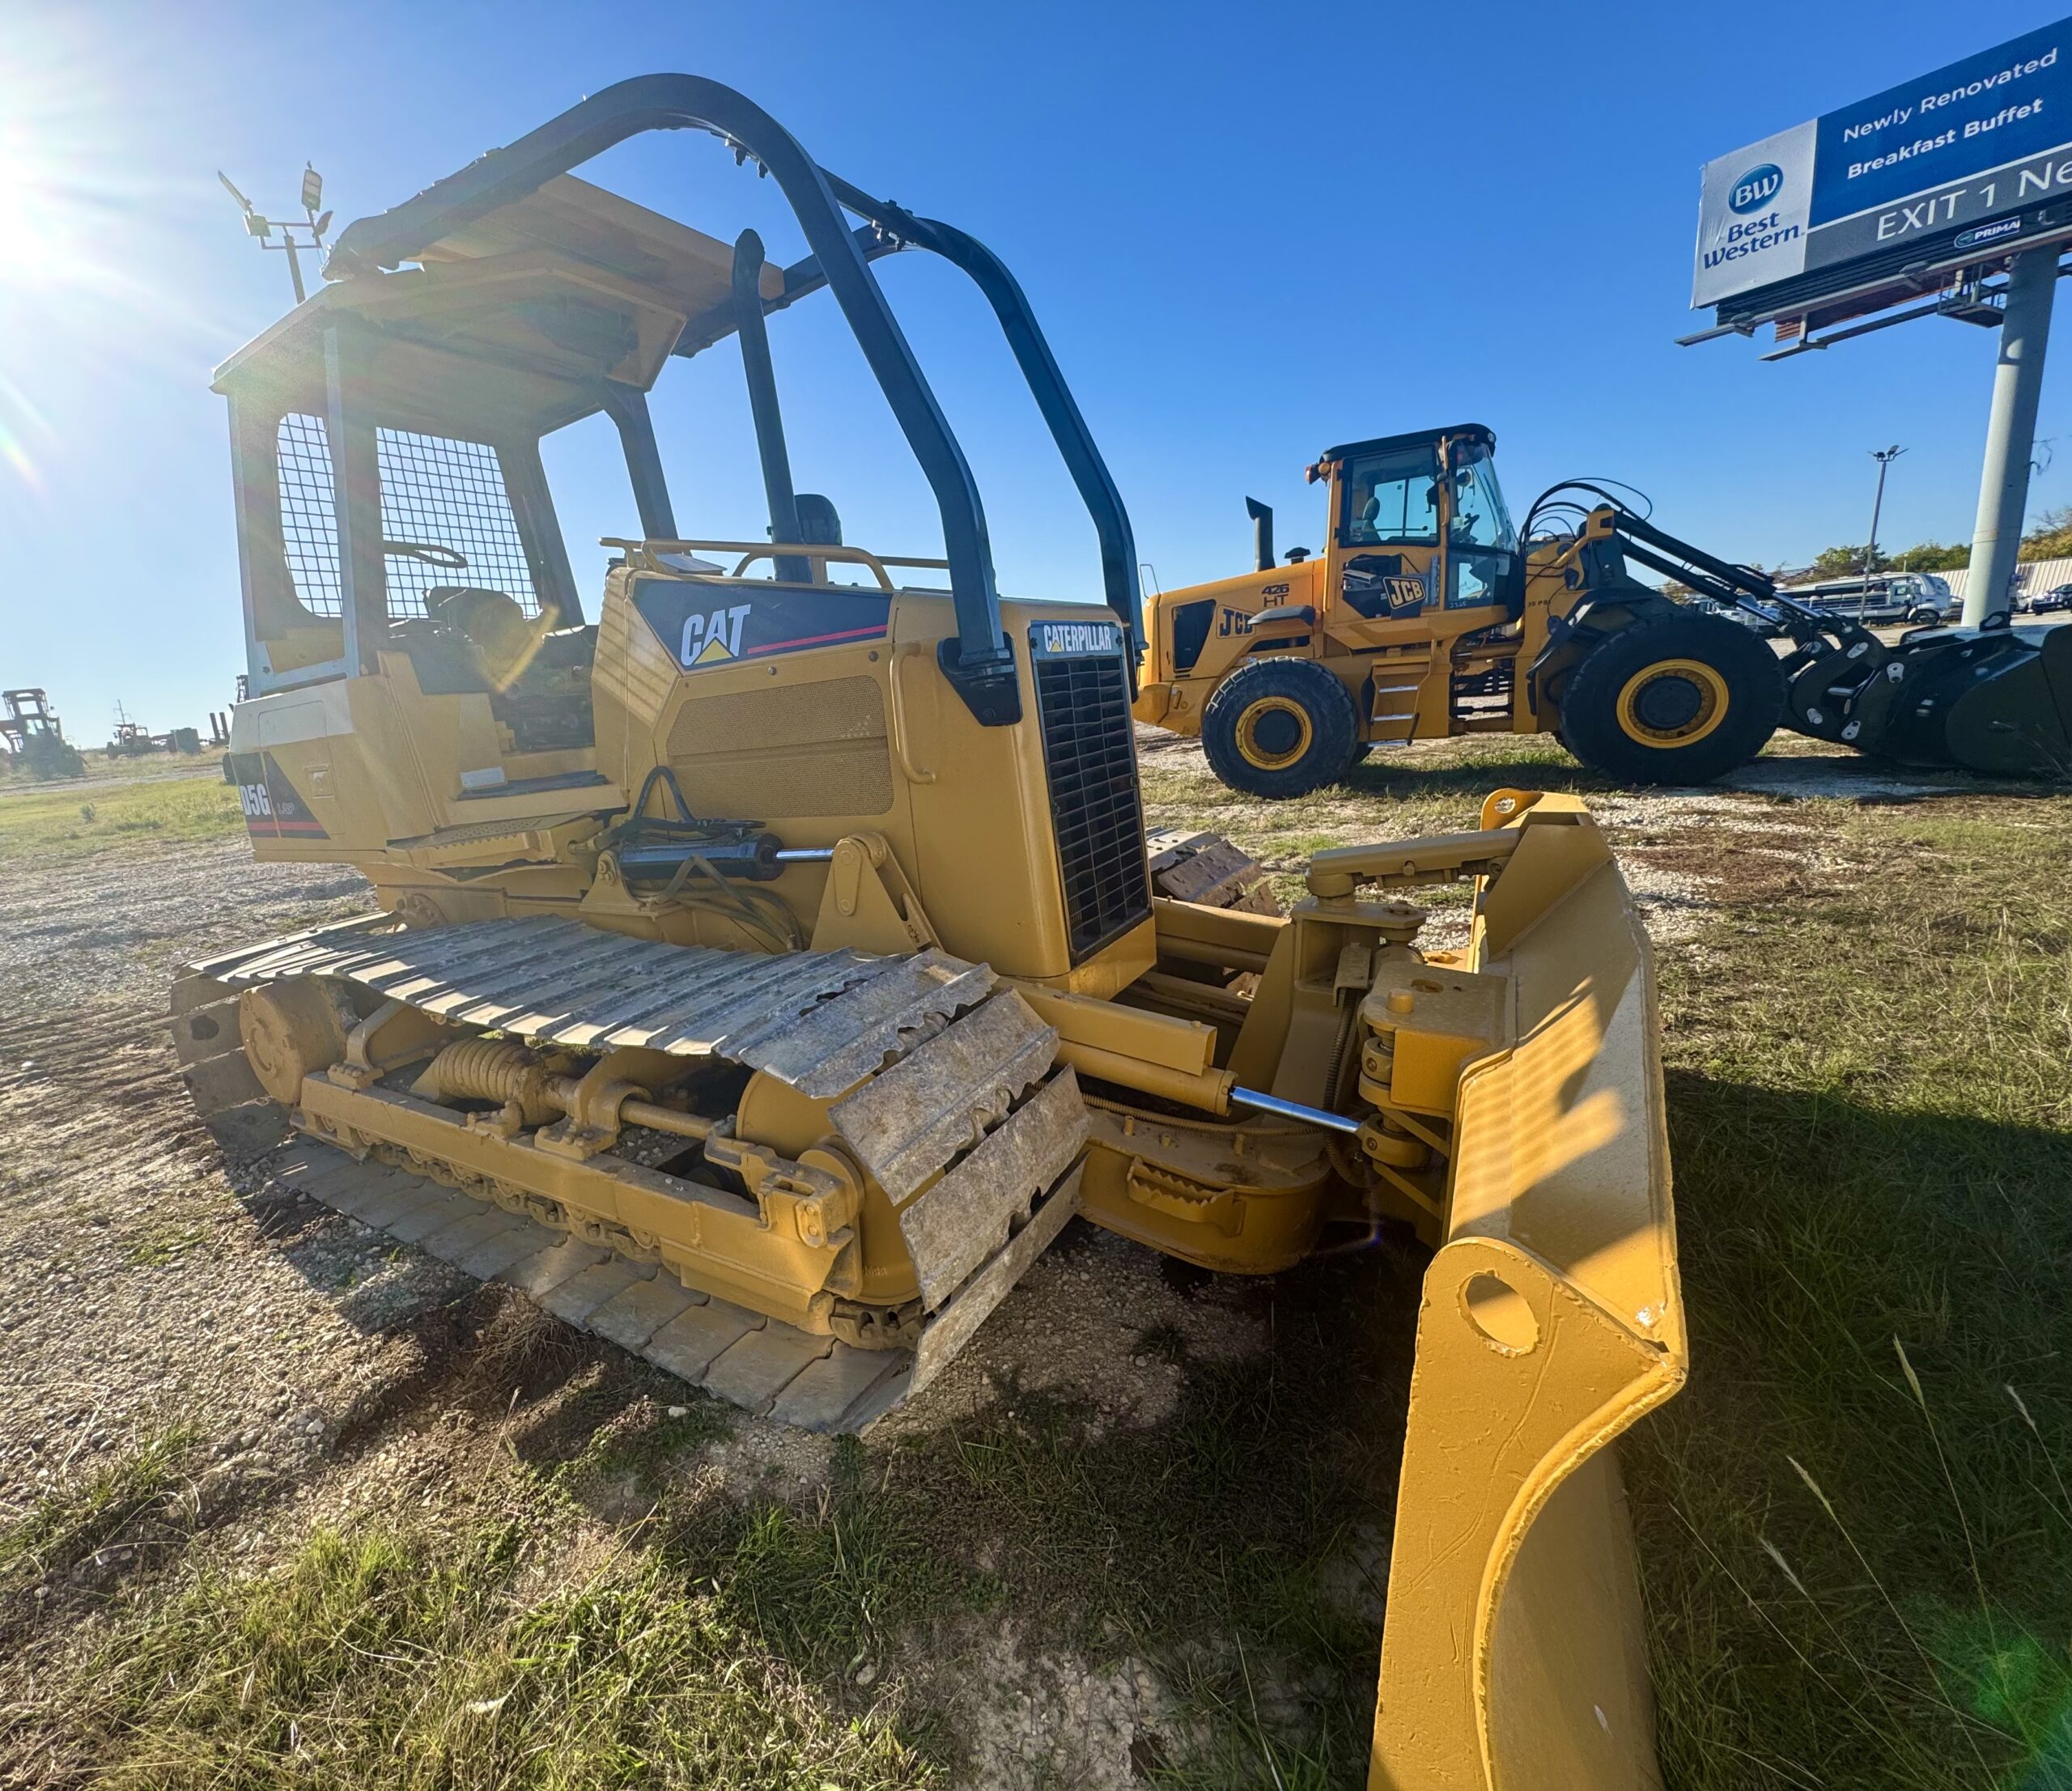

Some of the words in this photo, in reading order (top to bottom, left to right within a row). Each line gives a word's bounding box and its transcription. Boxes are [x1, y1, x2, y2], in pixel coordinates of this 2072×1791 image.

[1844, 106, 1913, 142] Newly
[1920, 47, 2057, 113] Renovated
[1847, 129, 1955, 180] Breakfast
[1964, 96, 2044, 138] Buffet
[1734, 173, 1779, 207] BW
[1728, 212, 1780, 243] Best
[1877, 189, 1967, 241] EXIT
[1979, 183, 1996, 208] 1
[1704, 225, 1799, 269] Western
[1261, 584, 1290, 595] 426
[1263, 594, 1289, 607] HT
[1391, 579, 1423, 606] JCB
[681, 603, 752, 666] CAT
[1043, 624, 1112, 652] CATERPILLAR
[240, 783, 271, 816] D5G
